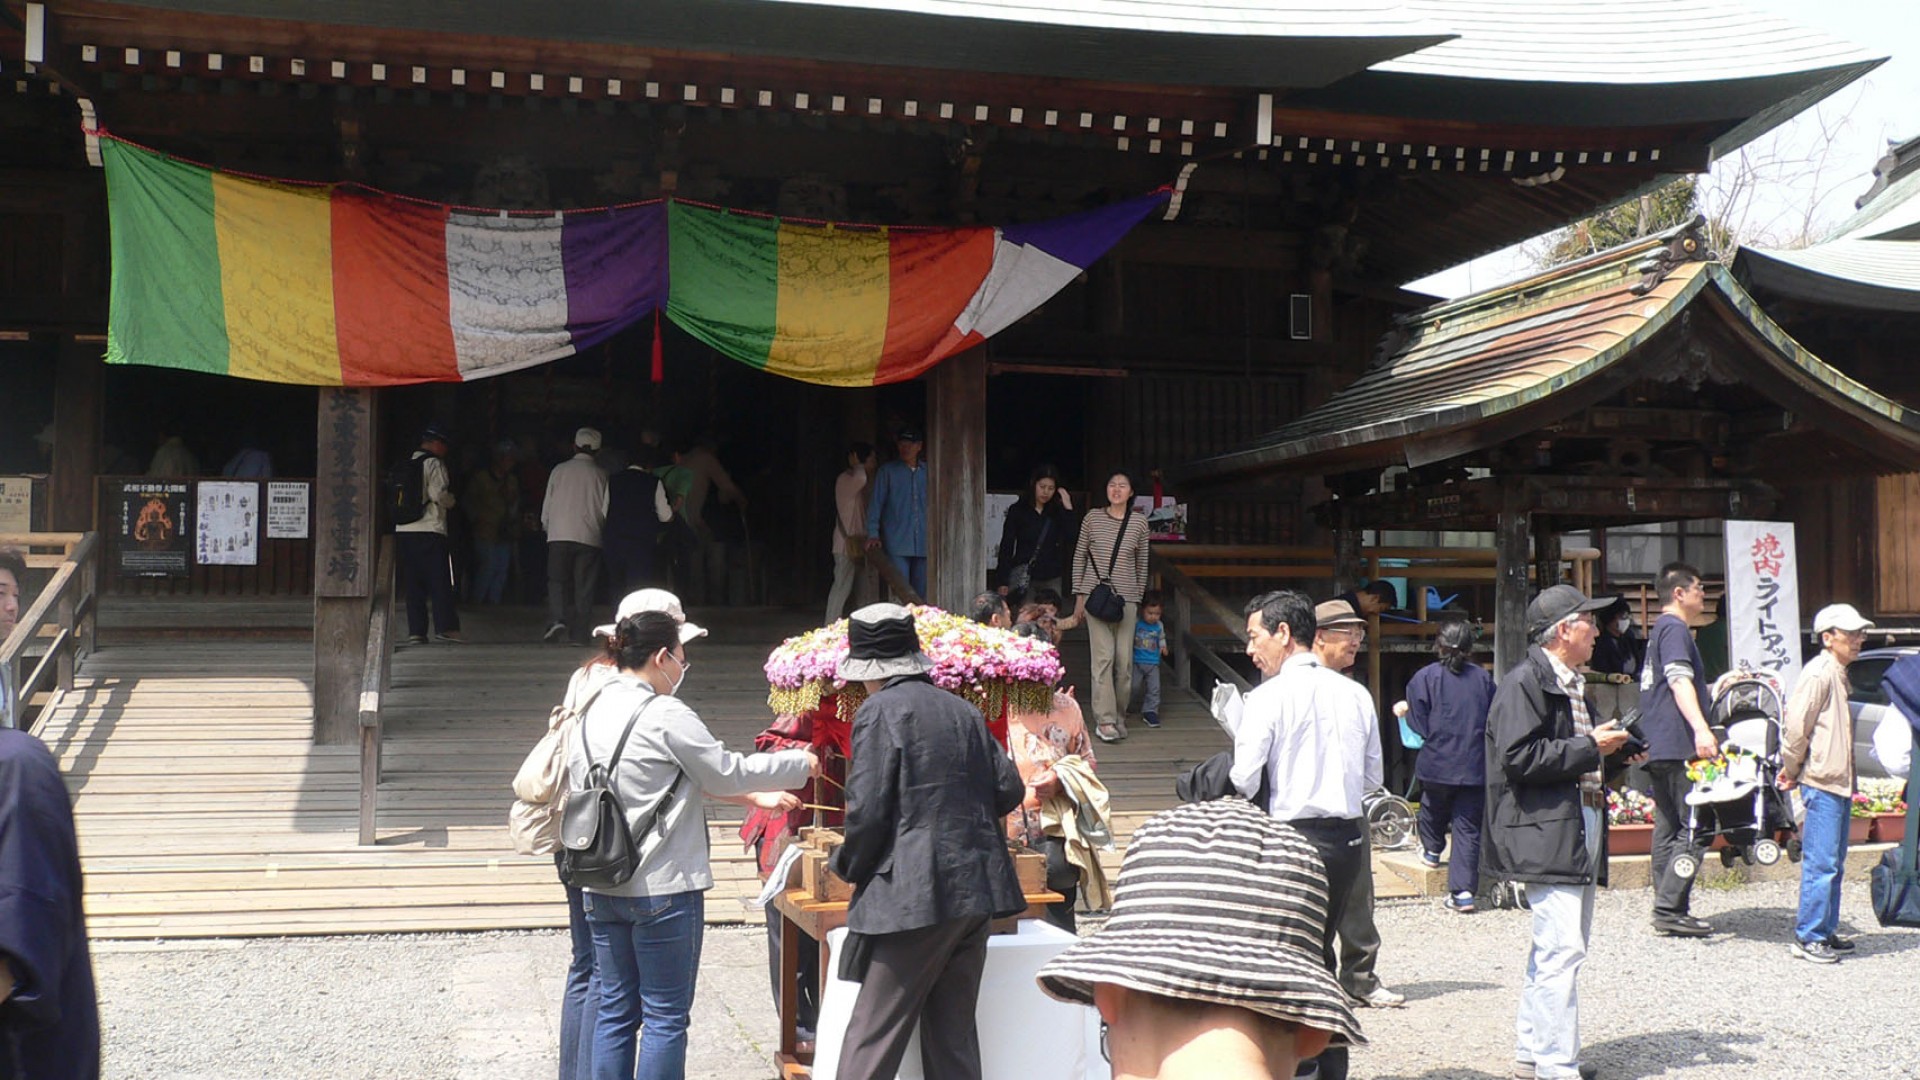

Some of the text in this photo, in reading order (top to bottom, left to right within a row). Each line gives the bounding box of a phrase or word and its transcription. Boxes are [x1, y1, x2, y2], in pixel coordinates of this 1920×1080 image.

[1751, 532, 1791, 671] 境内ライトアップ
